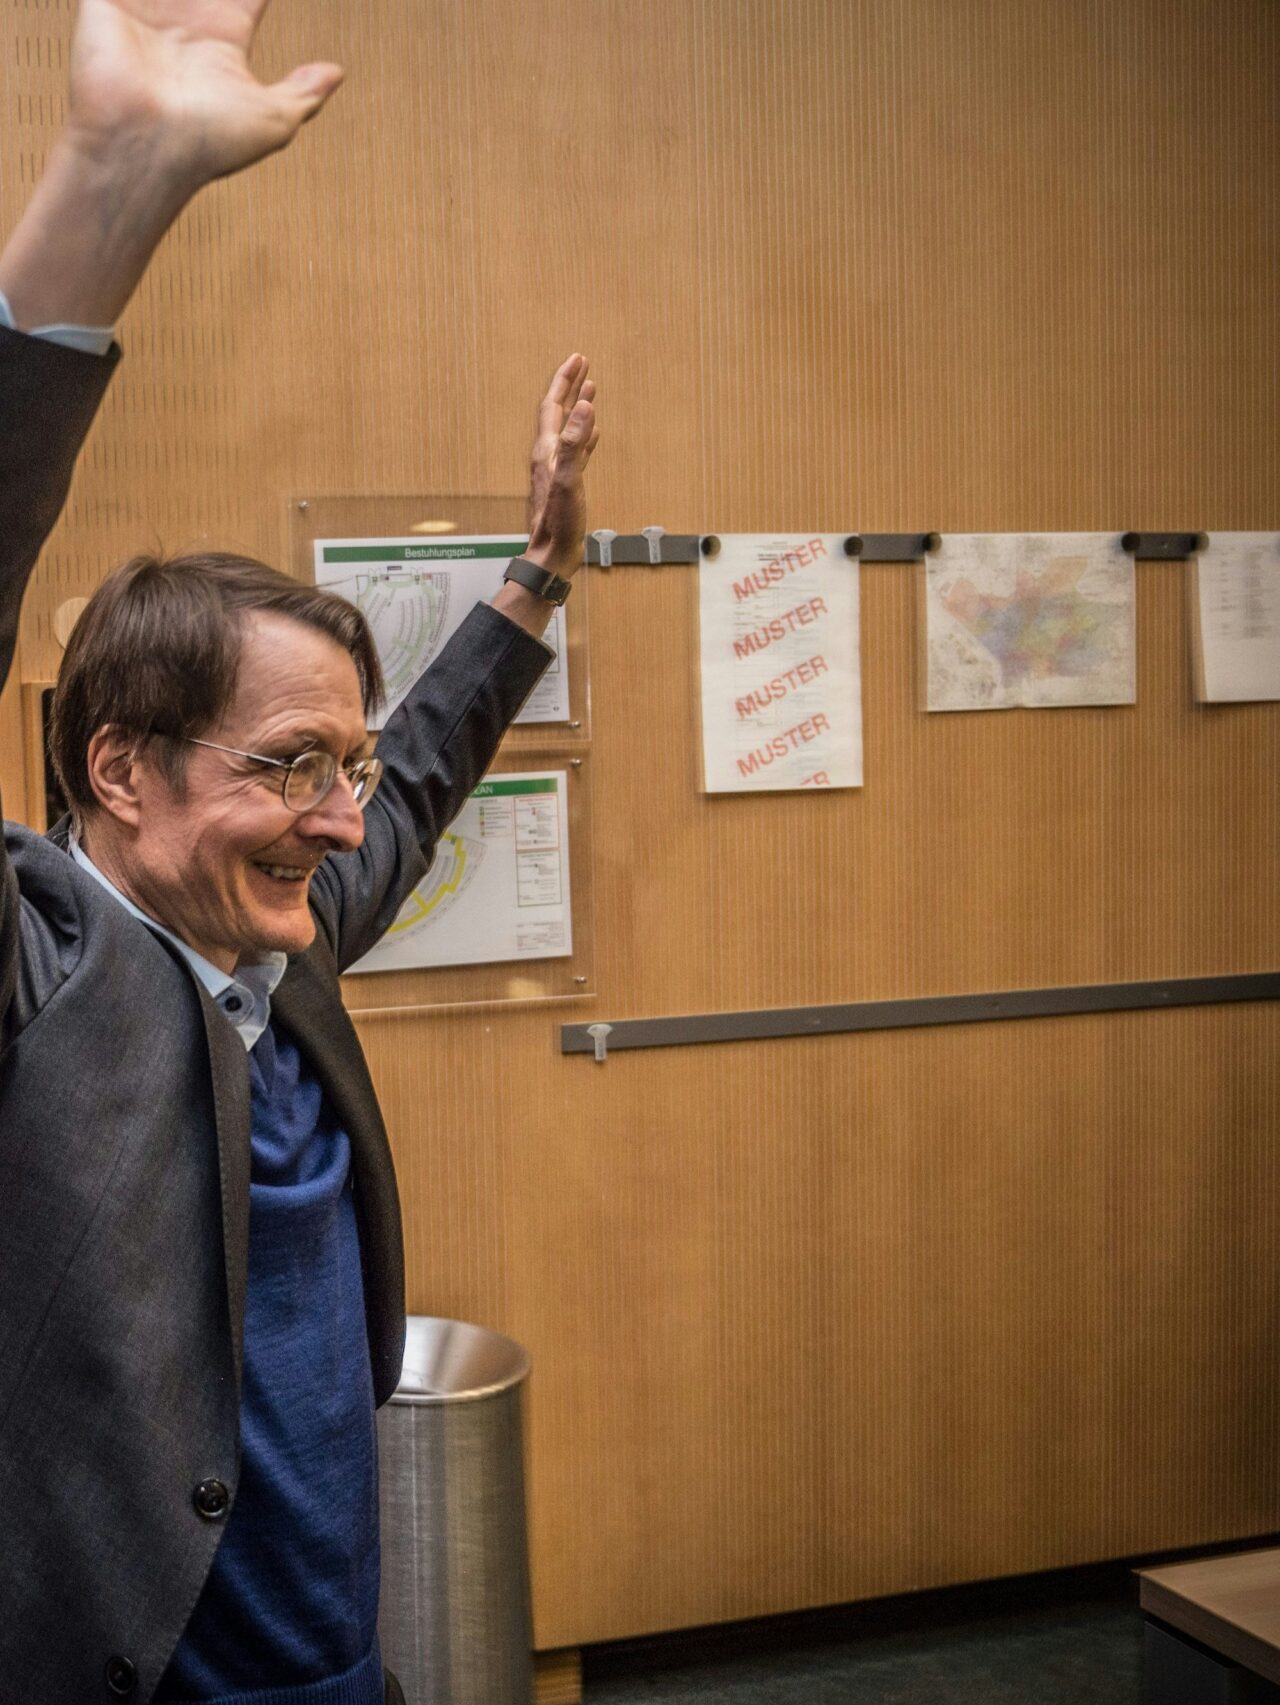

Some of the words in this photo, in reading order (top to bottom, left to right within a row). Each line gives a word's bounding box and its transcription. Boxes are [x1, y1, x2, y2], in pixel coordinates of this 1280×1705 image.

[405, 547, 475, 558] Bestuhlungsplan
[732, 538, 827, 601] MUSTER
[732, 597, 828, 660] MUSTER
[734, 655, 829, 718] MUSTER
[736, 713, 831, 777] MUSTER
